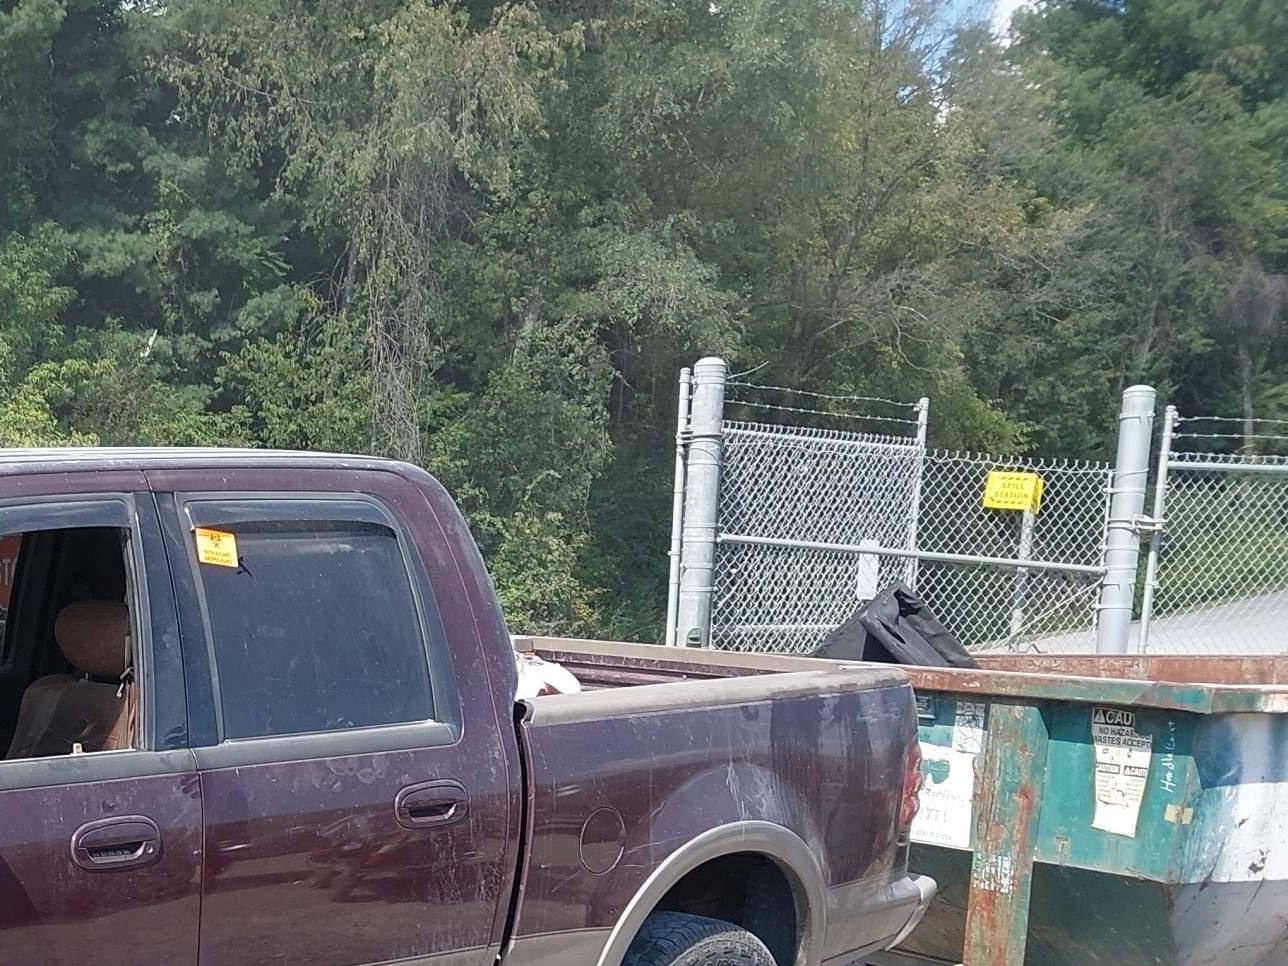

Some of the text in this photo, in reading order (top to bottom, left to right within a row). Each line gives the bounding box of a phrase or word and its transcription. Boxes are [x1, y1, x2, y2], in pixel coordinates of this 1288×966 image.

[1001, 482, 1024, 490] SPILL
[993, 491, 1029, 499] STATION
[1105, 711, 1136, 726] CAU
[1122, 738, 1152, 749] ACCEPT
